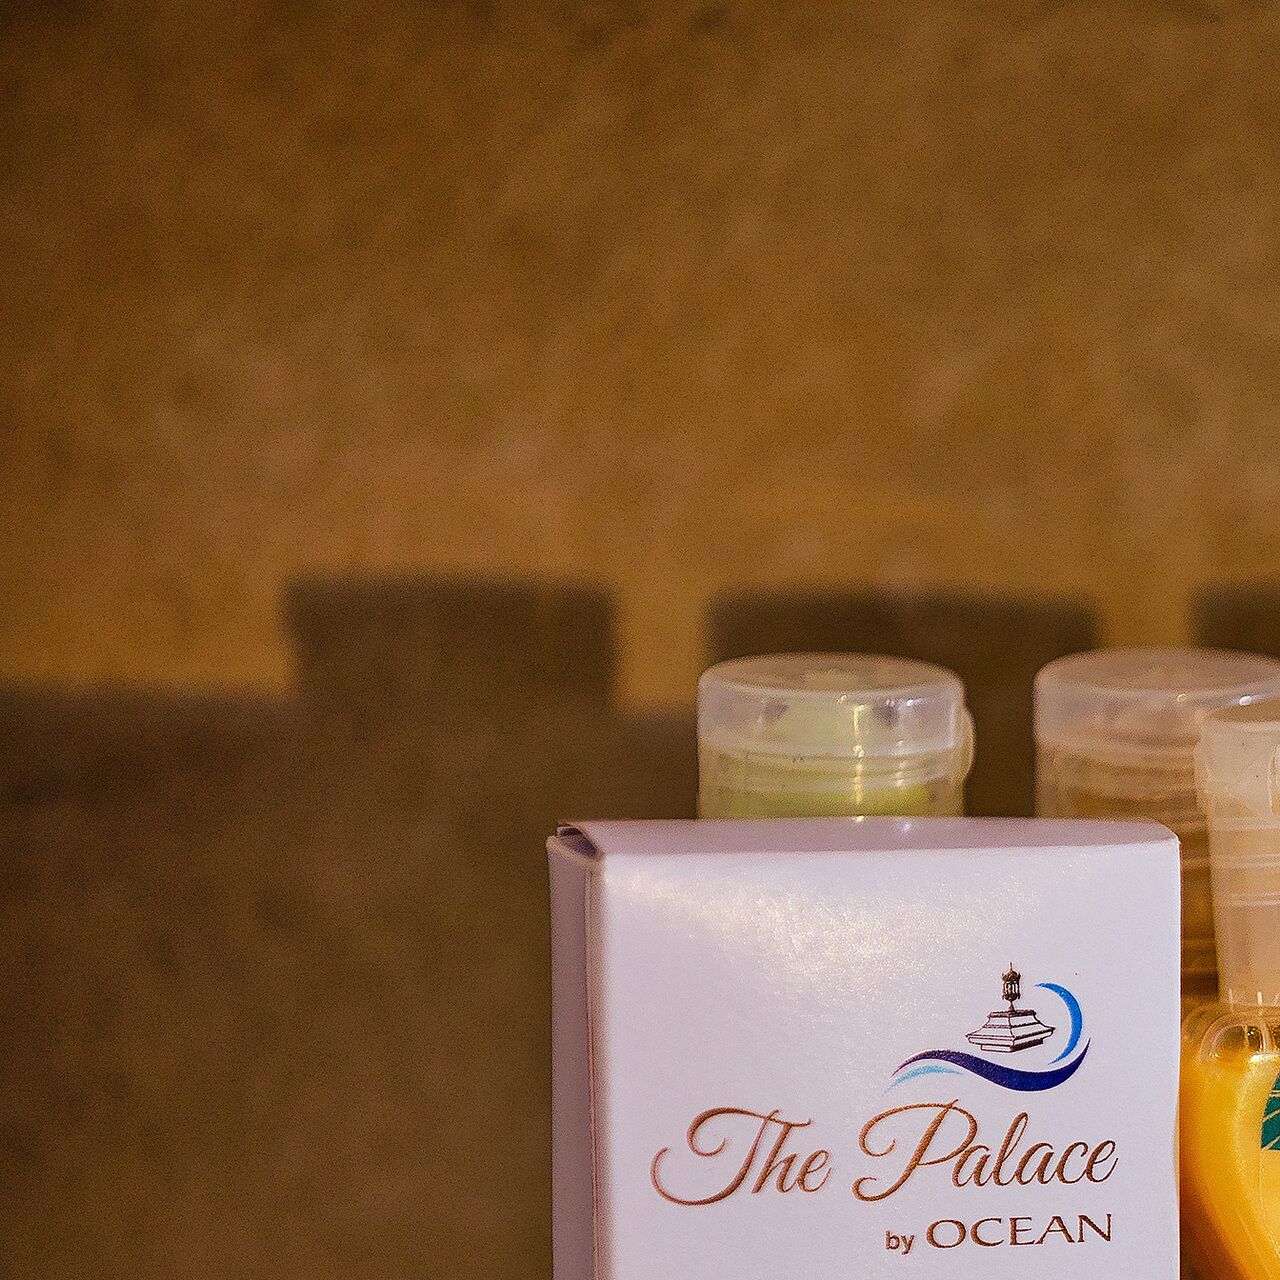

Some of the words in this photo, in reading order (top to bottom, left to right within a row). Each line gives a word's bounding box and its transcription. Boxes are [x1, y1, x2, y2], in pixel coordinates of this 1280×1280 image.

[650, 1106, 832, 1207] The
[851, 1098, 1119, 1202] Palace
[885, 1229, 915, 1255] by
[926, 1212, 1113, 1250] OCEAN
